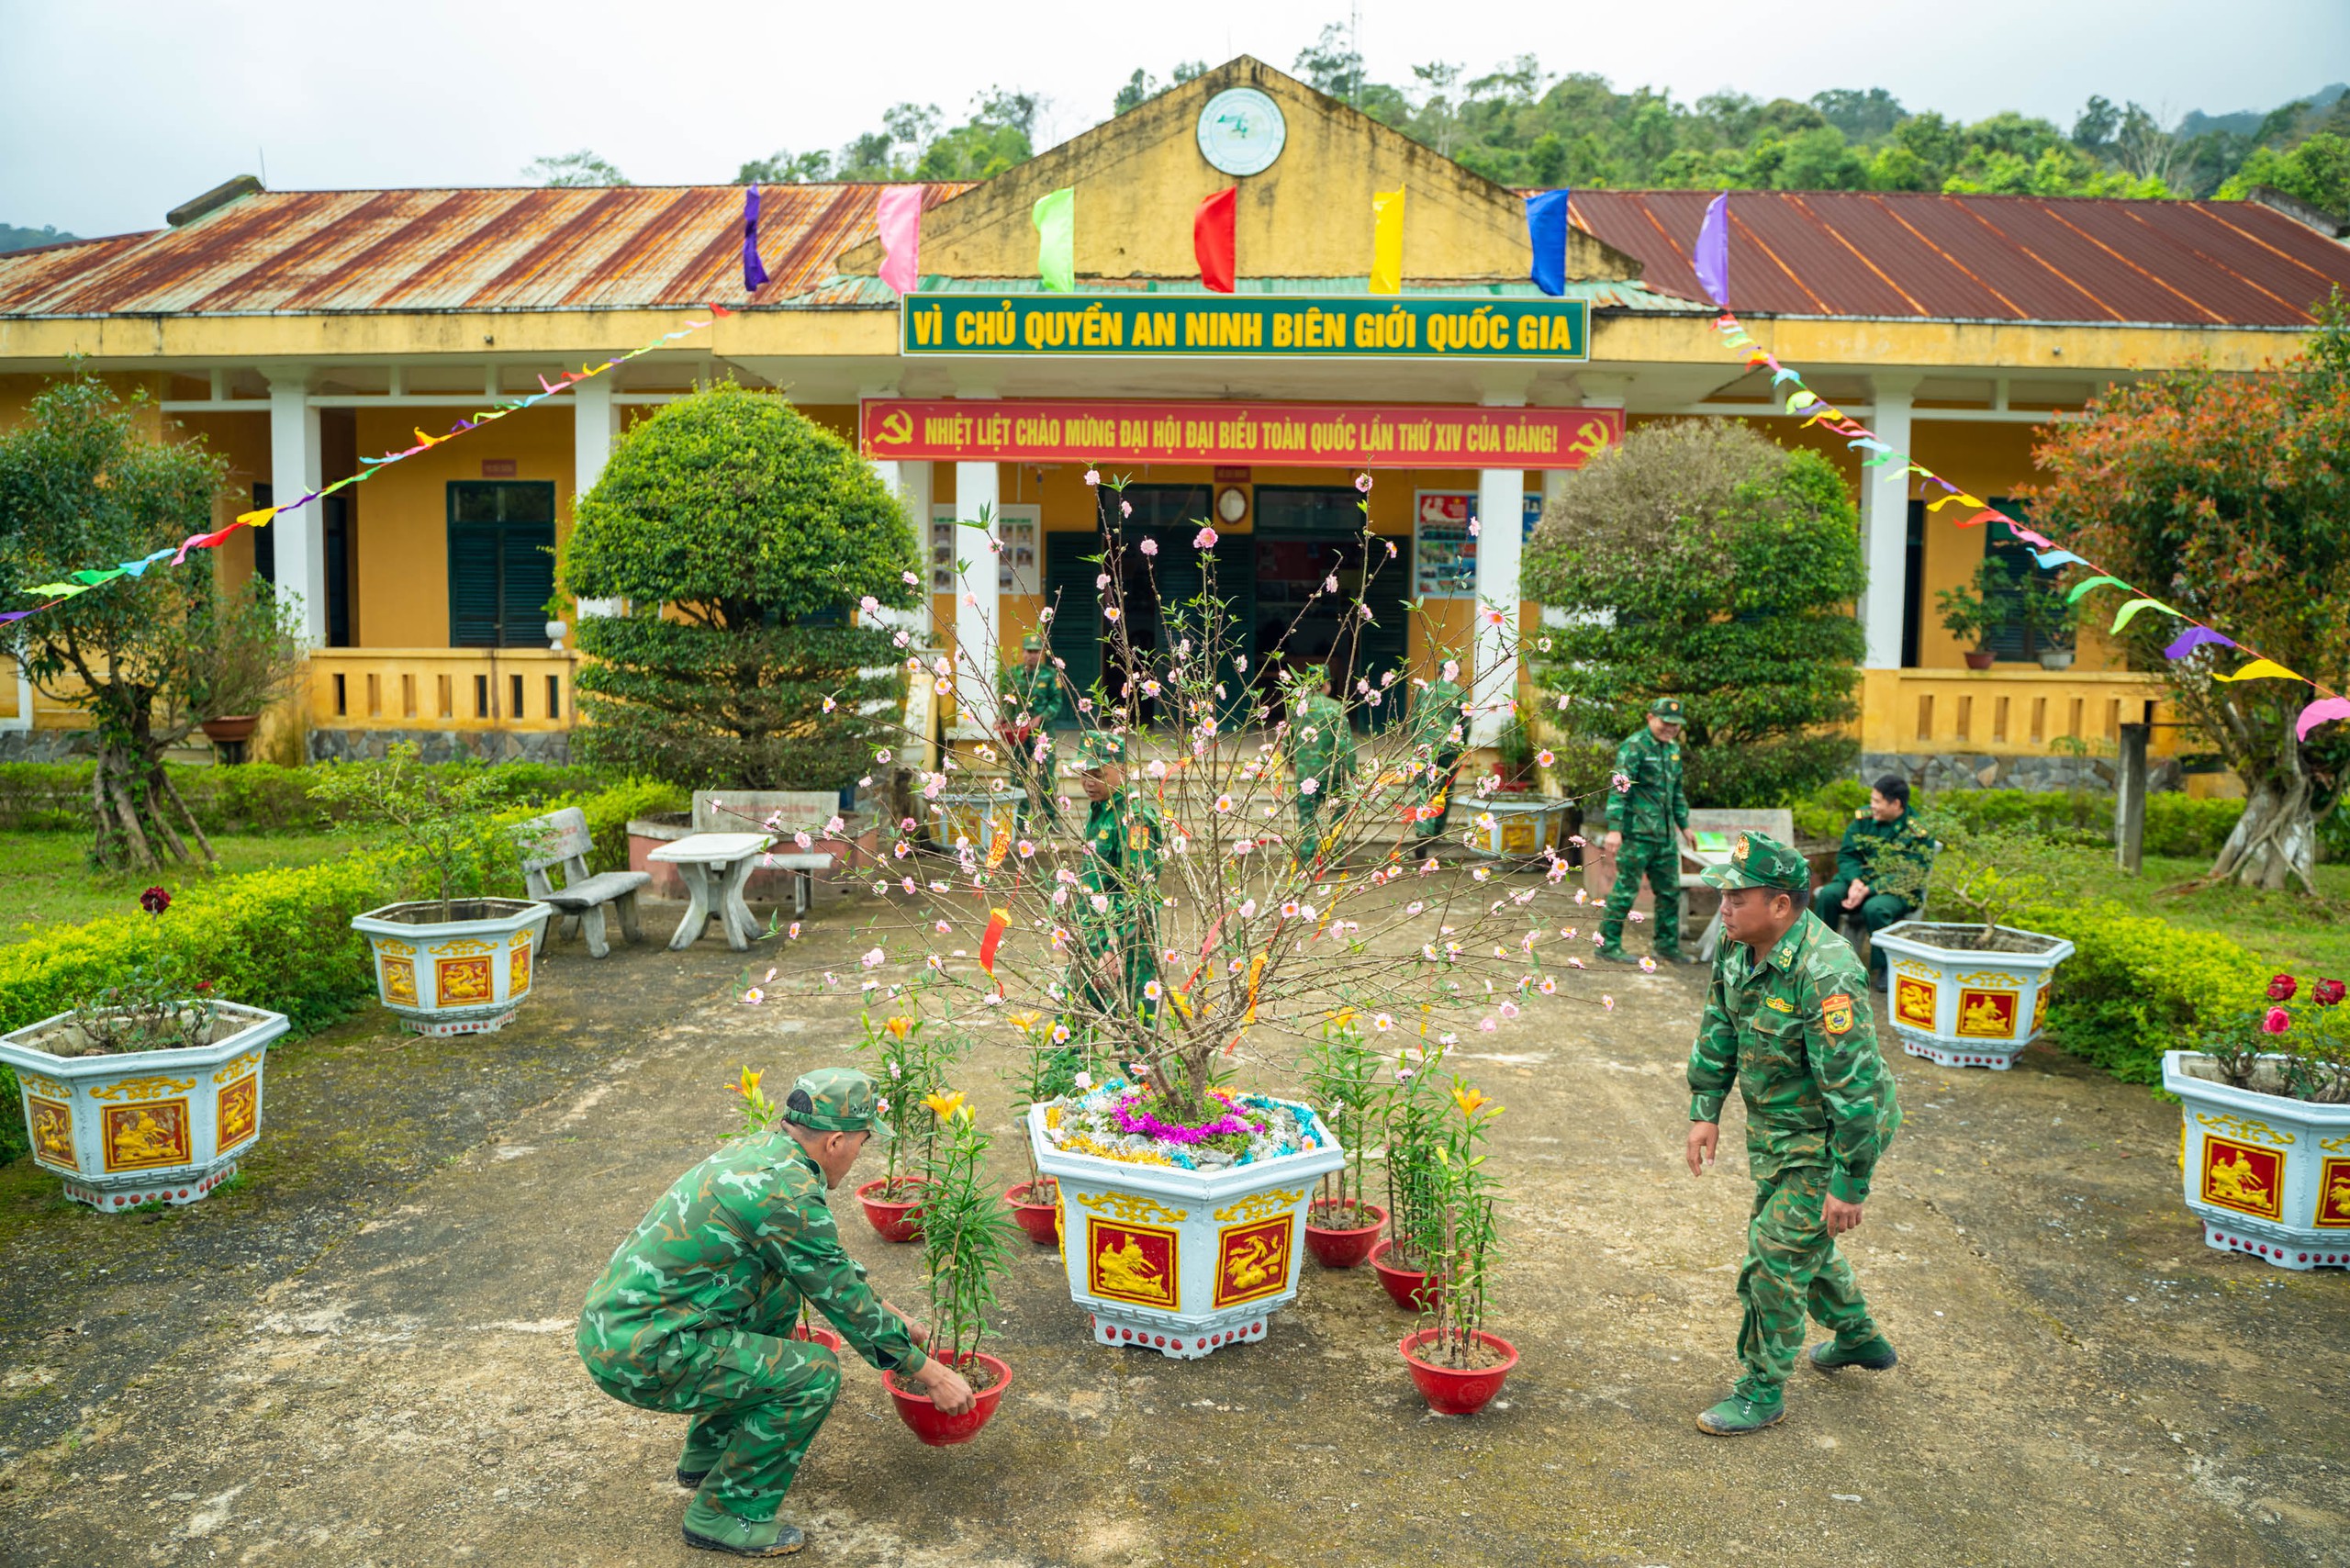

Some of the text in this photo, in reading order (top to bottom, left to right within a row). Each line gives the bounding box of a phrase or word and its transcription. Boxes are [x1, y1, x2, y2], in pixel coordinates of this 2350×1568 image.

[913, 300, 1572, 352] VÌ CHỦ QUYỀN AN NINH BIÊN GIỚI QUỐC GIA
[924, 410, 1559, 454] NHIỆT LIỆT CHÀO MỪNG ĐẠI HỘI ĐẠI BIỂU TOÀN QUỐC LẦN THỨ XIV CỦA ĐẢNG!
